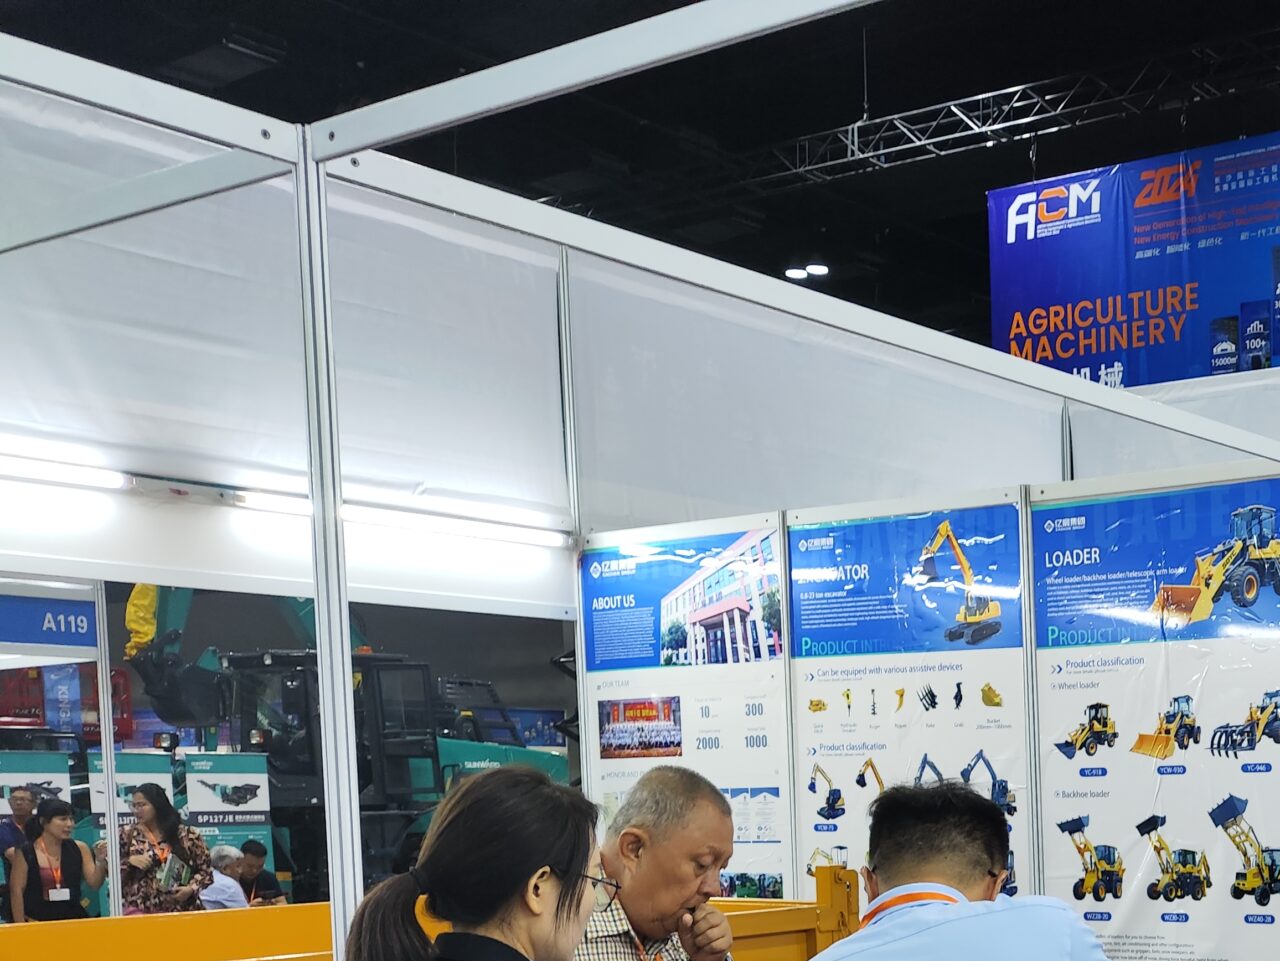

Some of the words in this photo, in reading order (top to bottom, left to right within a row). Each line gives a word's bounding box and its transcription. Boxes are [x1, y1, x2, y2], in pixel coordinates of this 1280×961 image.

[1134, 160, 1202, 209] 2024
[1007, 179, 1101, 245] ACM
[1134, 225, 1151, 234] New
[1134, 236, 1151, 245] New
[1152, 231, 1180, 242] Energy
[1009, 282, 1199, 339] AGRICULTURE
[1010, 313, 1187, 363] MACHINERY
[1245, 337, 1266, 350] 100+
[1045, 547, 1100, 568] LOADER
[592, 595, 622, 611] ABOUT
[622, 594, 636, 608] US
[42, 612, 88, 634] A119
[1047, 625, 1113, 647] PRODUCT
[801, 636, 858, 656] PRODUCT
[1065, 658, 1095, 669] Product
[1096, 655, 1145, 668] classification
[817, 668, 830, 678] Can
[830, 668, 839, 677] be
[839, 665, 867, 678] equiped
[868, 665, 883, 675] with
[884, 664, 908, 674] various
[908, 663, 936, 673] assistive
[937, 662, 963, 672] devices
[1058, 681, 1079, 690] Wheel
[1079, 681, 1100, 689] loader
[700, 705, 710, 719] 10
[745, 702, 764, 716] 300
[696, 736, 720, 750] 2000
[745, 734, 768, 748] 1000
[819, 743, 845, 752] Product
[845, 741, 887, 751] classification
[1061, 789, 1089, 799] Backhoe
[1089, 789, 1110, 799] loader
